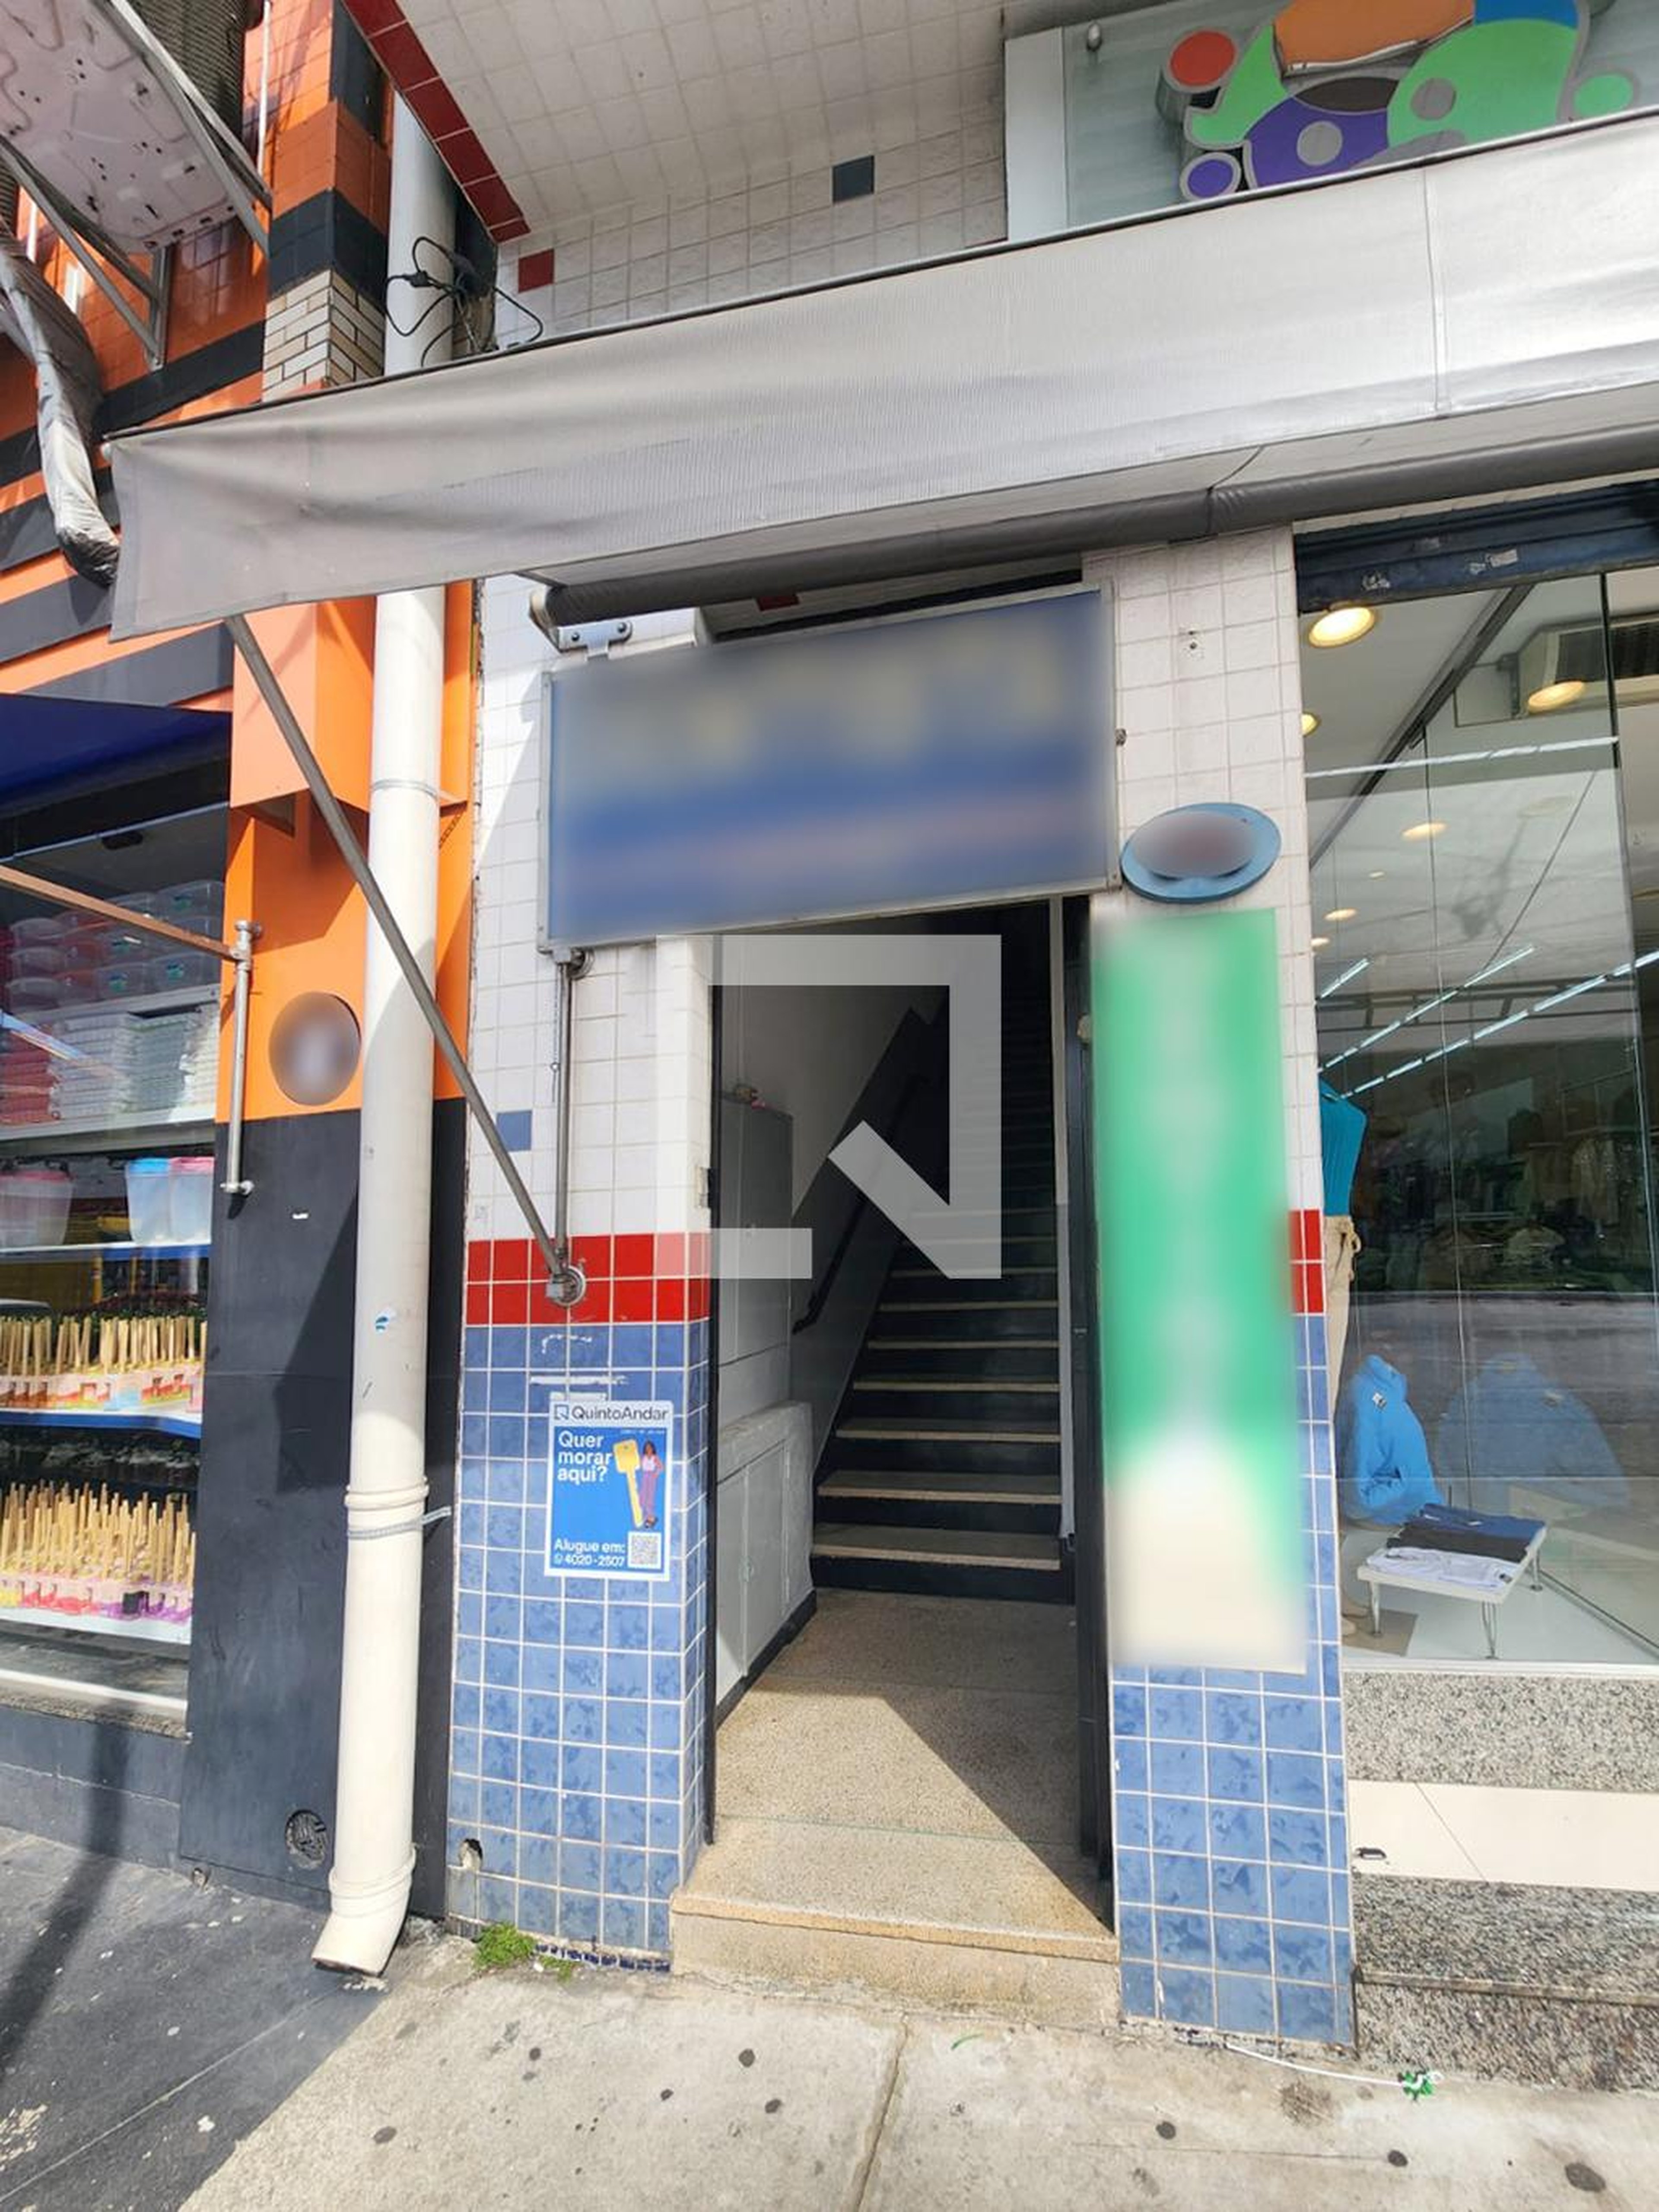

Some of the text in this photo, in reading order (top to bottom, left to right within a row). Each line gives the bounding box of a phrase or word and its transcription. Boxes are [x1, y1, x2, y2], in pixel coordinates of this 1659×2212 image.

[572, 1406, 668, 1420] QuintoAndar
[558, 1430, 604, 1448] Quer
[558, 1451, 612, 1465] morar
[557, 1465, 607, 1485] aqui?
[554, 1538, 599, 1553] Alugue
